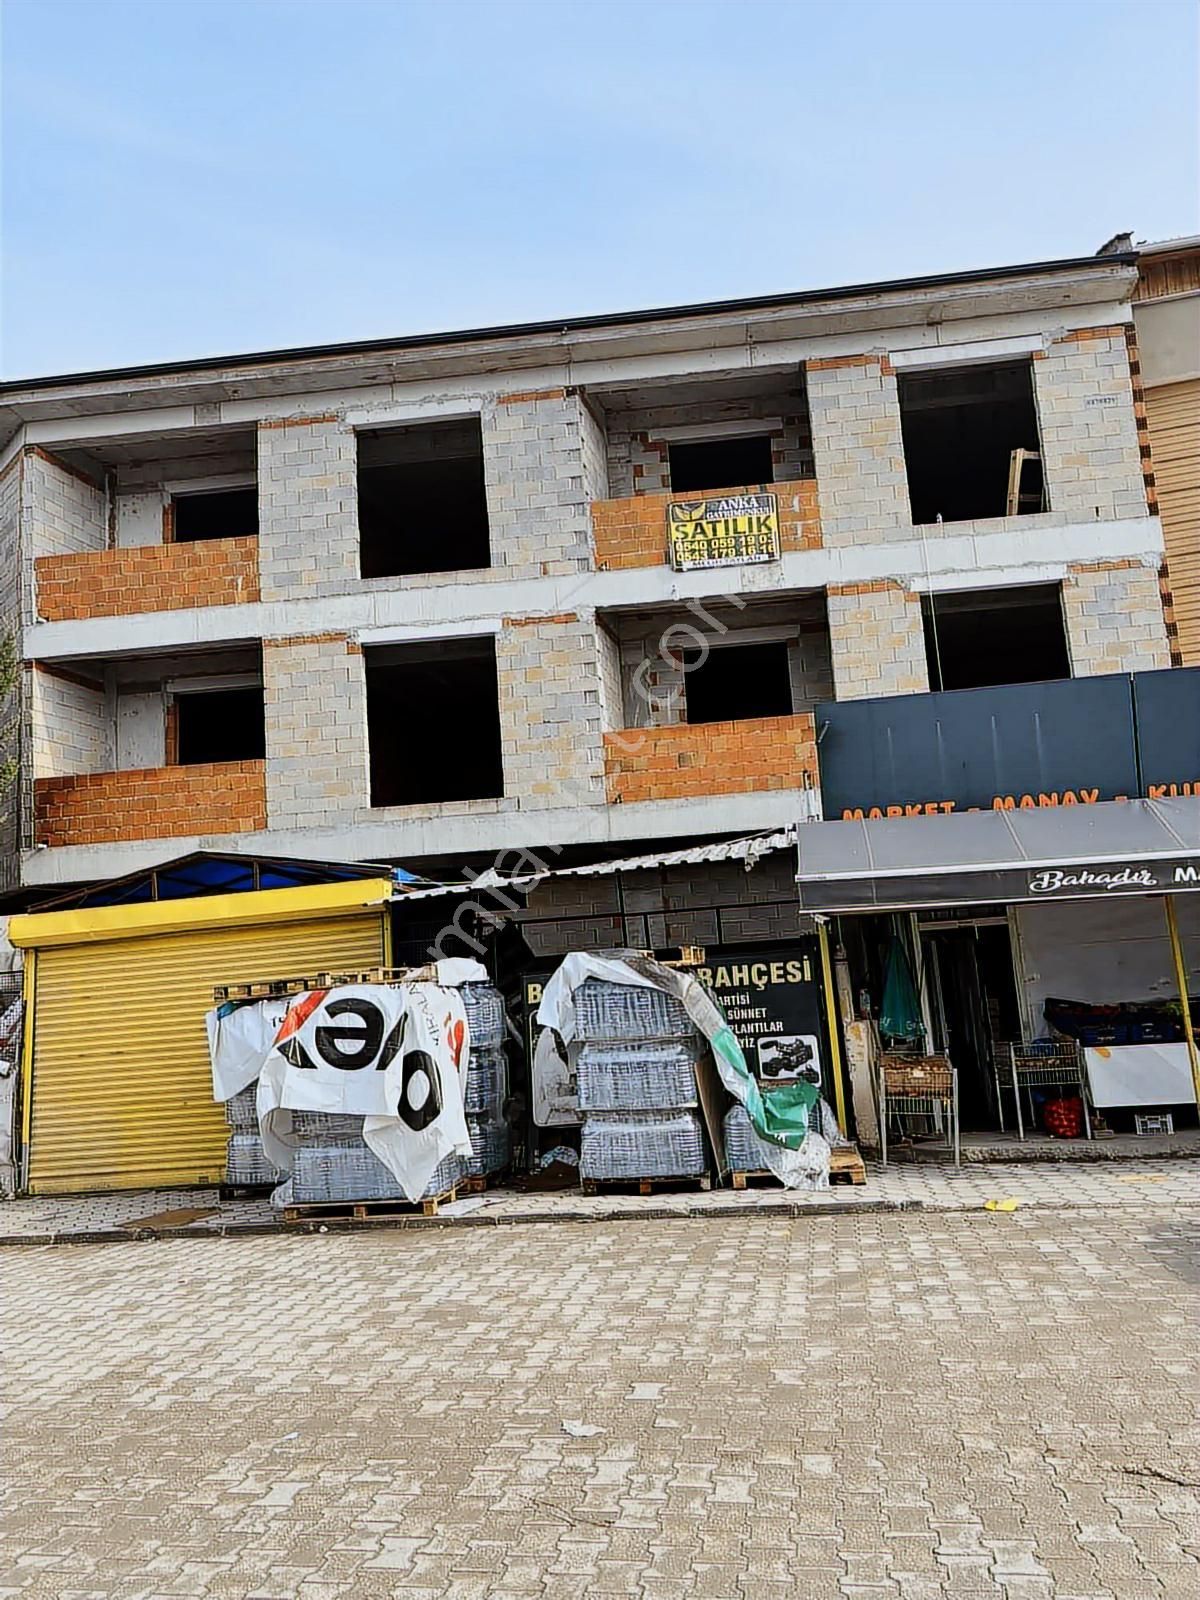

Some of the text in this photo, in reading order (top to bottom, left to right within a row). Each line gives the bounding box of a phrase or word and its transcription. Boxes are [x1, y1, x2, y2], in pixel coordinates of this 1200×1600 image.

[718, 496, 759, 511] ANKA
[674, 515, 773, 539] SATILIK
[675, 540, 708, 552] 0540
[711, 537, 736, 549] 059
[740, 535, 755, 547] 19
[676, 550, 709, 562] 0543
[711, 547, 736, 559] 179
[740, 546, 755, 557] 16
[842, 801, 955, 821] MARKET
[993, 788, 1099, 812] MANAV
[1149, 782, 1200, 800] KU
[697, 954, 812, 991] BAHÇESİ
[727, 1006, 768, 1021] SÜNNET
